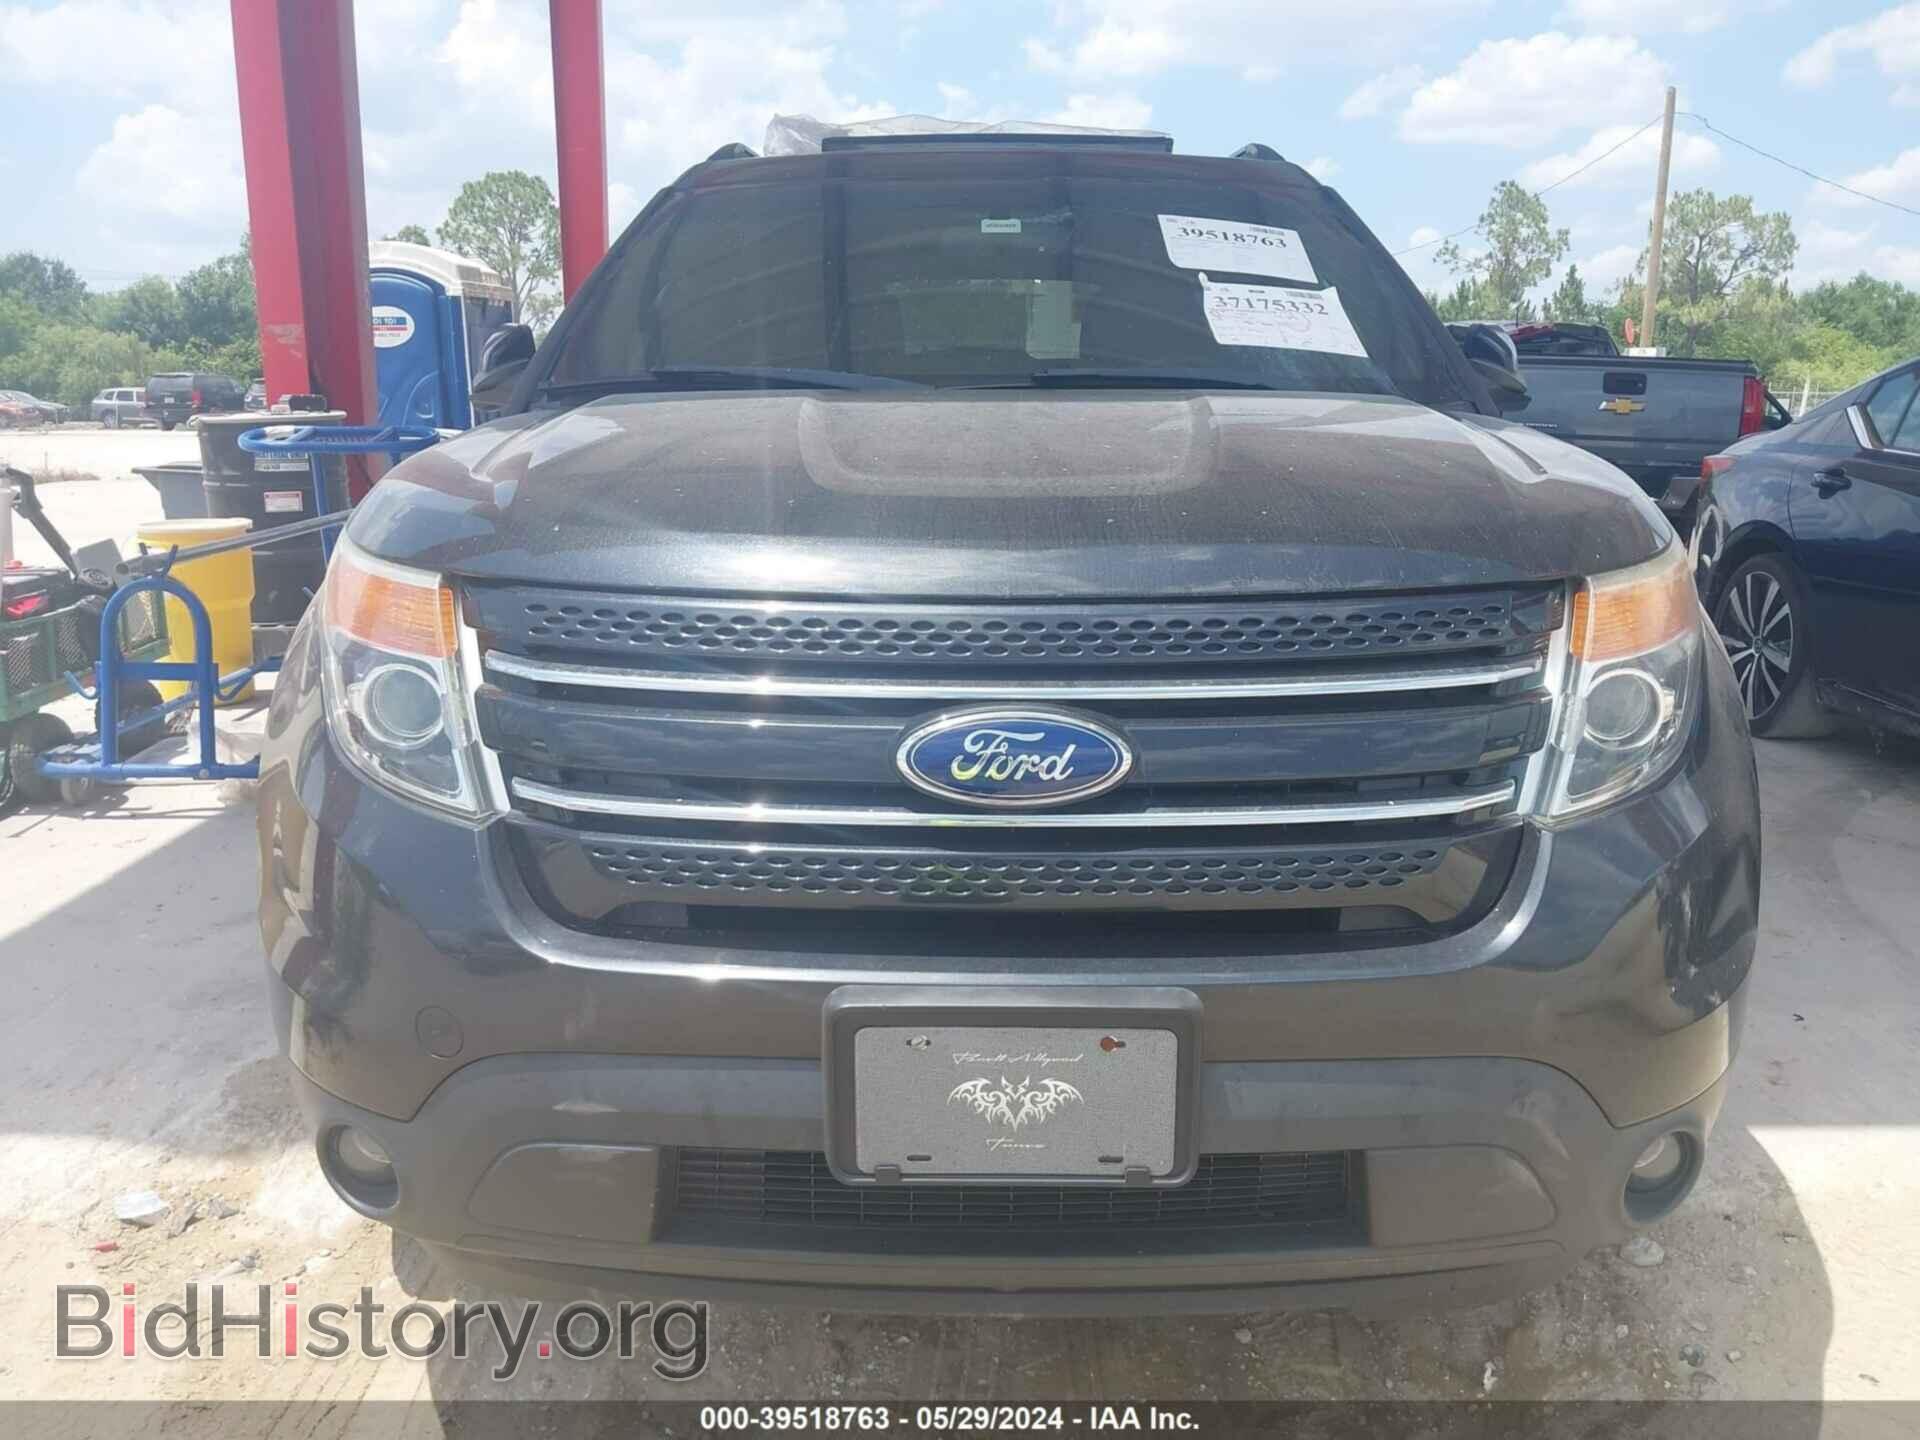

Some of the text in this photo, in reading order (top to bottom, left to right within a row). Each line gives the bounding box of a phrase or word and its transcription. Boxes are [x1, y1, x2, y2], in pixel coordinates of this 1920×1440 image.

[1177, 226, 1287, 249] 39518763
[1213, 295, 1329, 316] 37175332
[950, 728, 1078, 781] Ford
